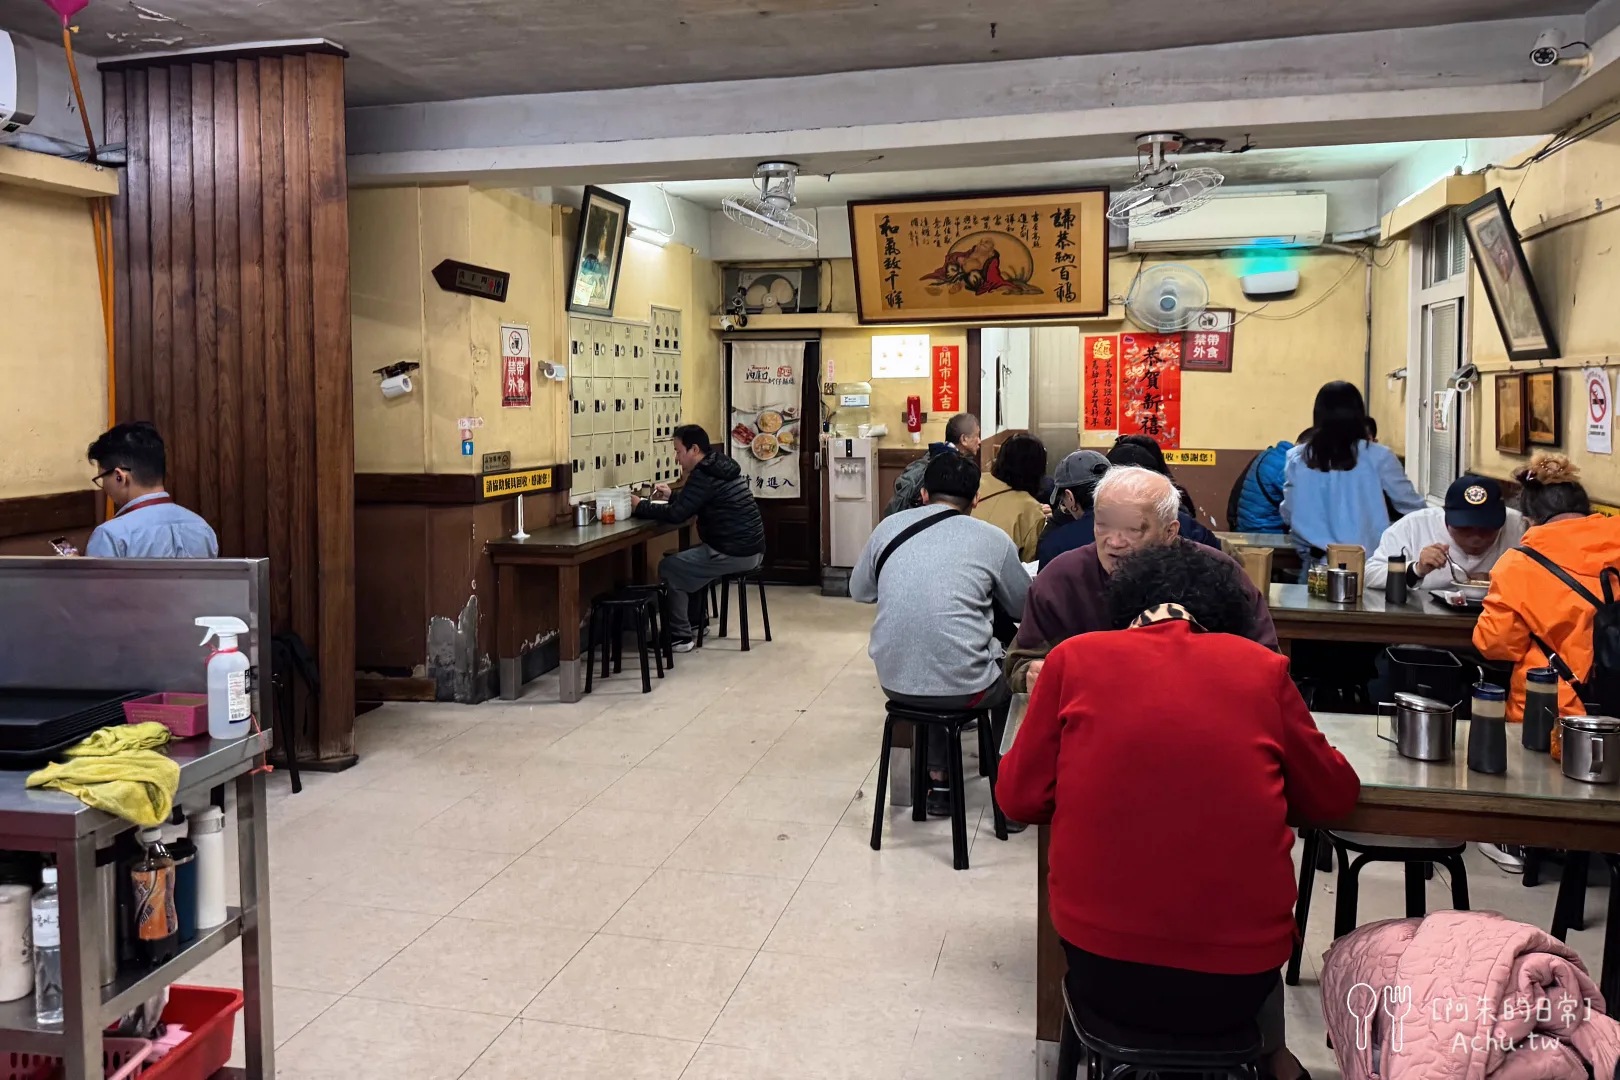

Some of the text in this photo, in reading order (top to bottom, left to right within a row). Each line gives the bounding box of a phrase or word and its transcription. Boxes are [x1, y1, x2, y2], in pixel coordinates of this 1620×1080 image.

[1049, 207, 1077, 303] 謙恭納百福
[1193, 346, 1219, 359] 外食
[1194, 333, 1220, 345] 禁帶
[508, 377, 525, 393] 外食
[939, 351, 953, 410] 開市大吉
[1139, 346, 1164, 435] 恭賀新禧
